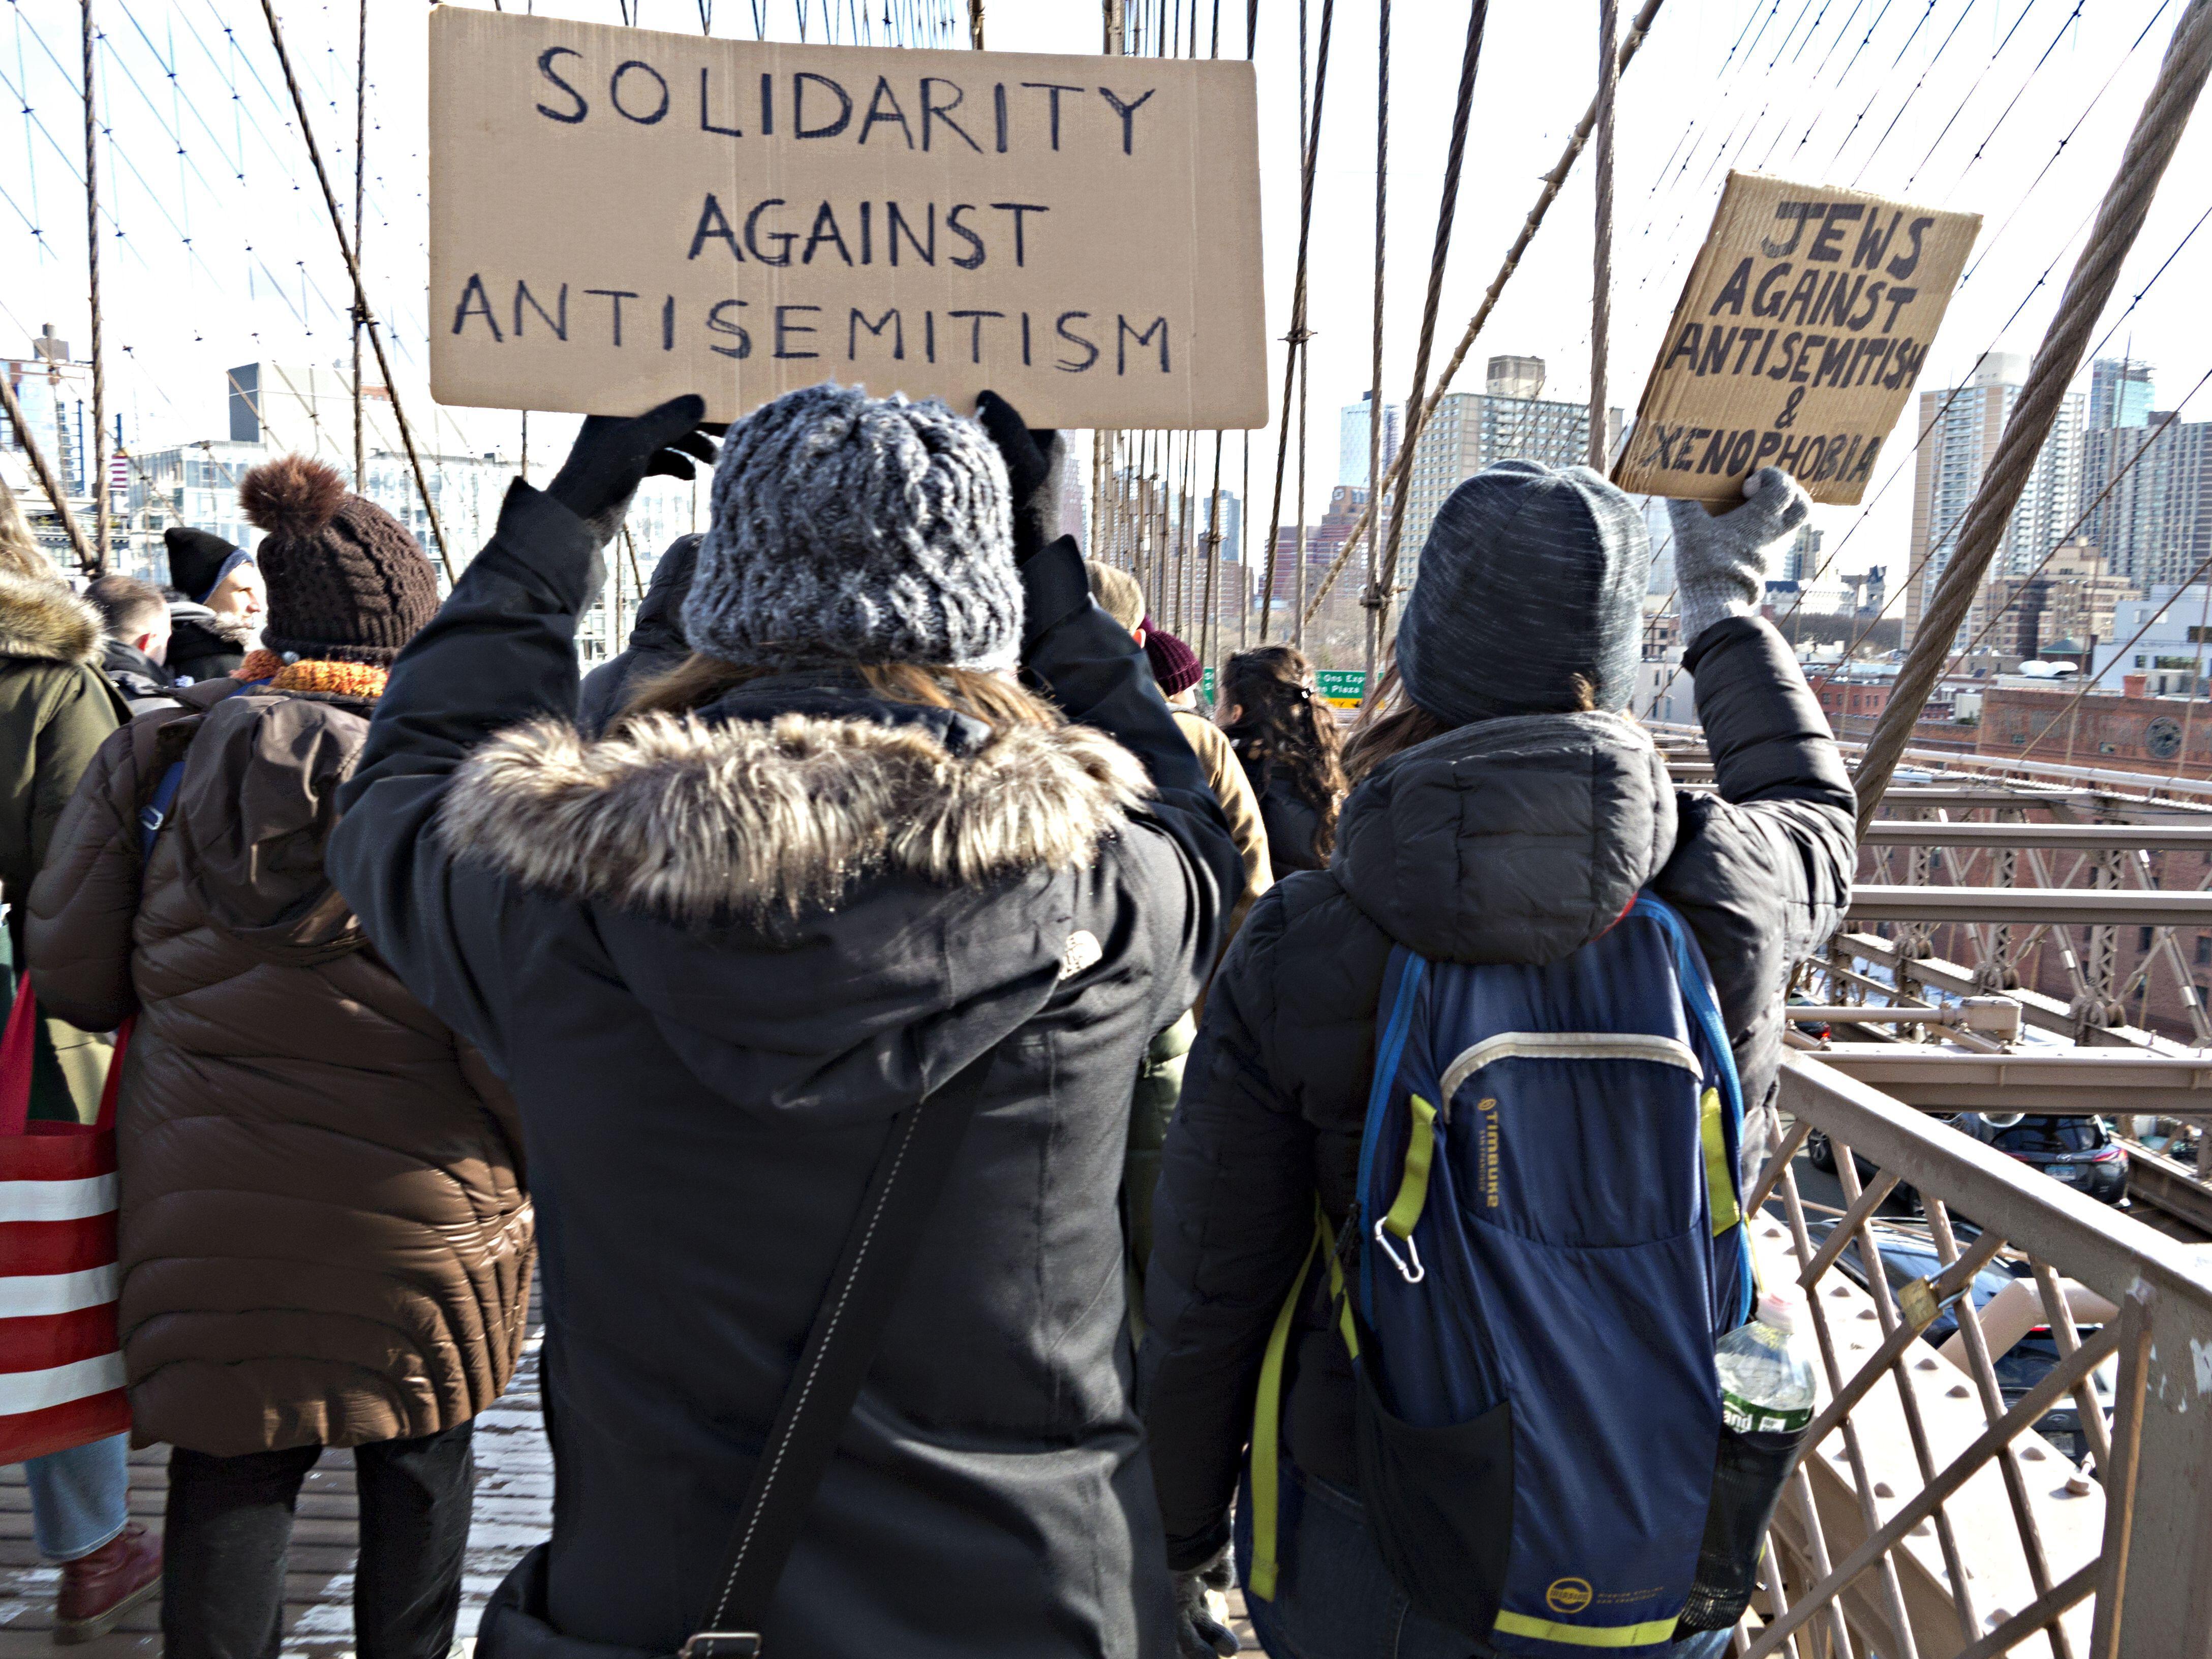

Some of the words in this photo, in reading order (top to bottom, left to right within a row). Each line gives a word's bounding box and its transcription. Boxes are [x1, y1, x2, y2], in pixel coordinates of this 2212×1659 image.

[536, 46, 1156, 156] SOLIDARITY
[687, 192, 1050, 270] AGAINST
[1761, 201, 1934, 281] JEWS
[451, 272, 1171, 376] ANTISEMITISM
[1709, 257, 1918, 333] AGAINST
[1774, 385, 1806, 430] &
[1642, 425, 1882, 483] XENOPHOBIA
[1332, 685, 1360, 693] Plaza
[1346, 674, 1366, 684] Exp
